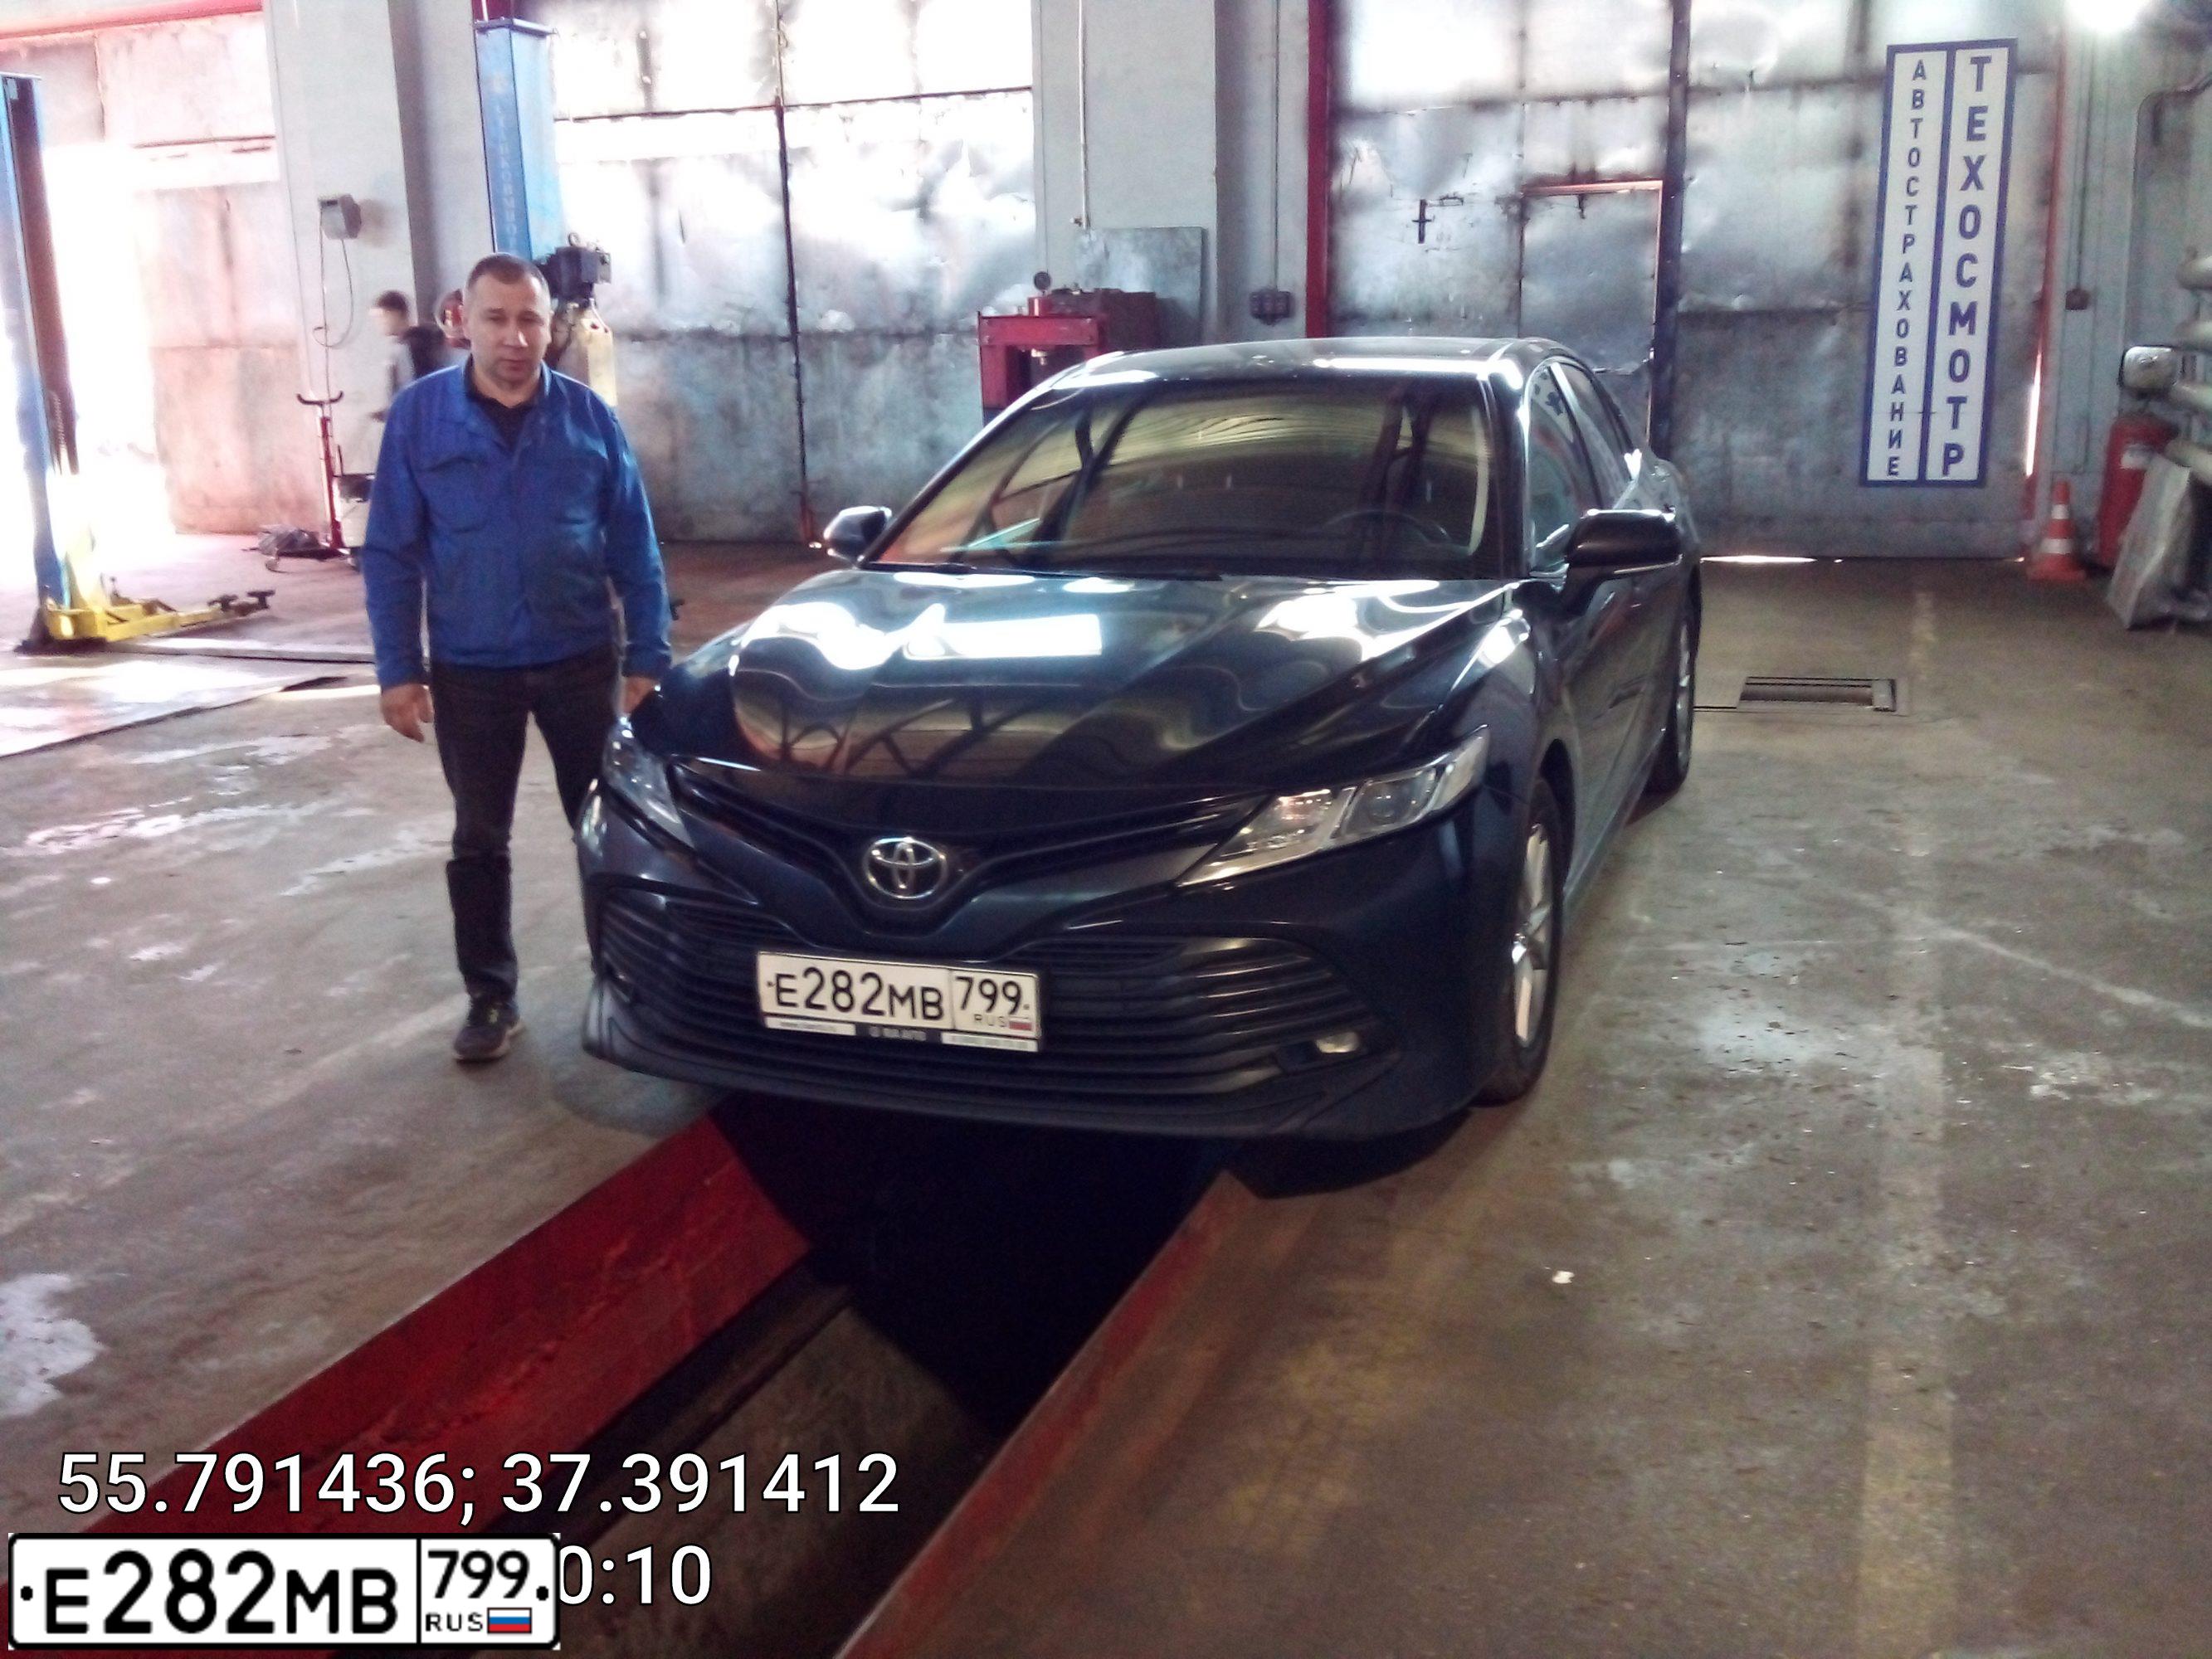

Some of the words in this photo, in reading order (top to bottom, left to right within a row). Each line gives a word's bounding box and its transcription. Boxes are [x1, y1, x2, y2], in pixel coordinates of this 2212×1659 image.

[1886, 59, 1927, 477] АВТОСТРАХОВАНИЕ
[1942, 56, 1992, 477] ТЕХОСМОТР
[773, 966, 944, 1021] Е282МВ
[955, 975, 1023, 1015] 799
[973, 1013, 1006, 1028] RUS
